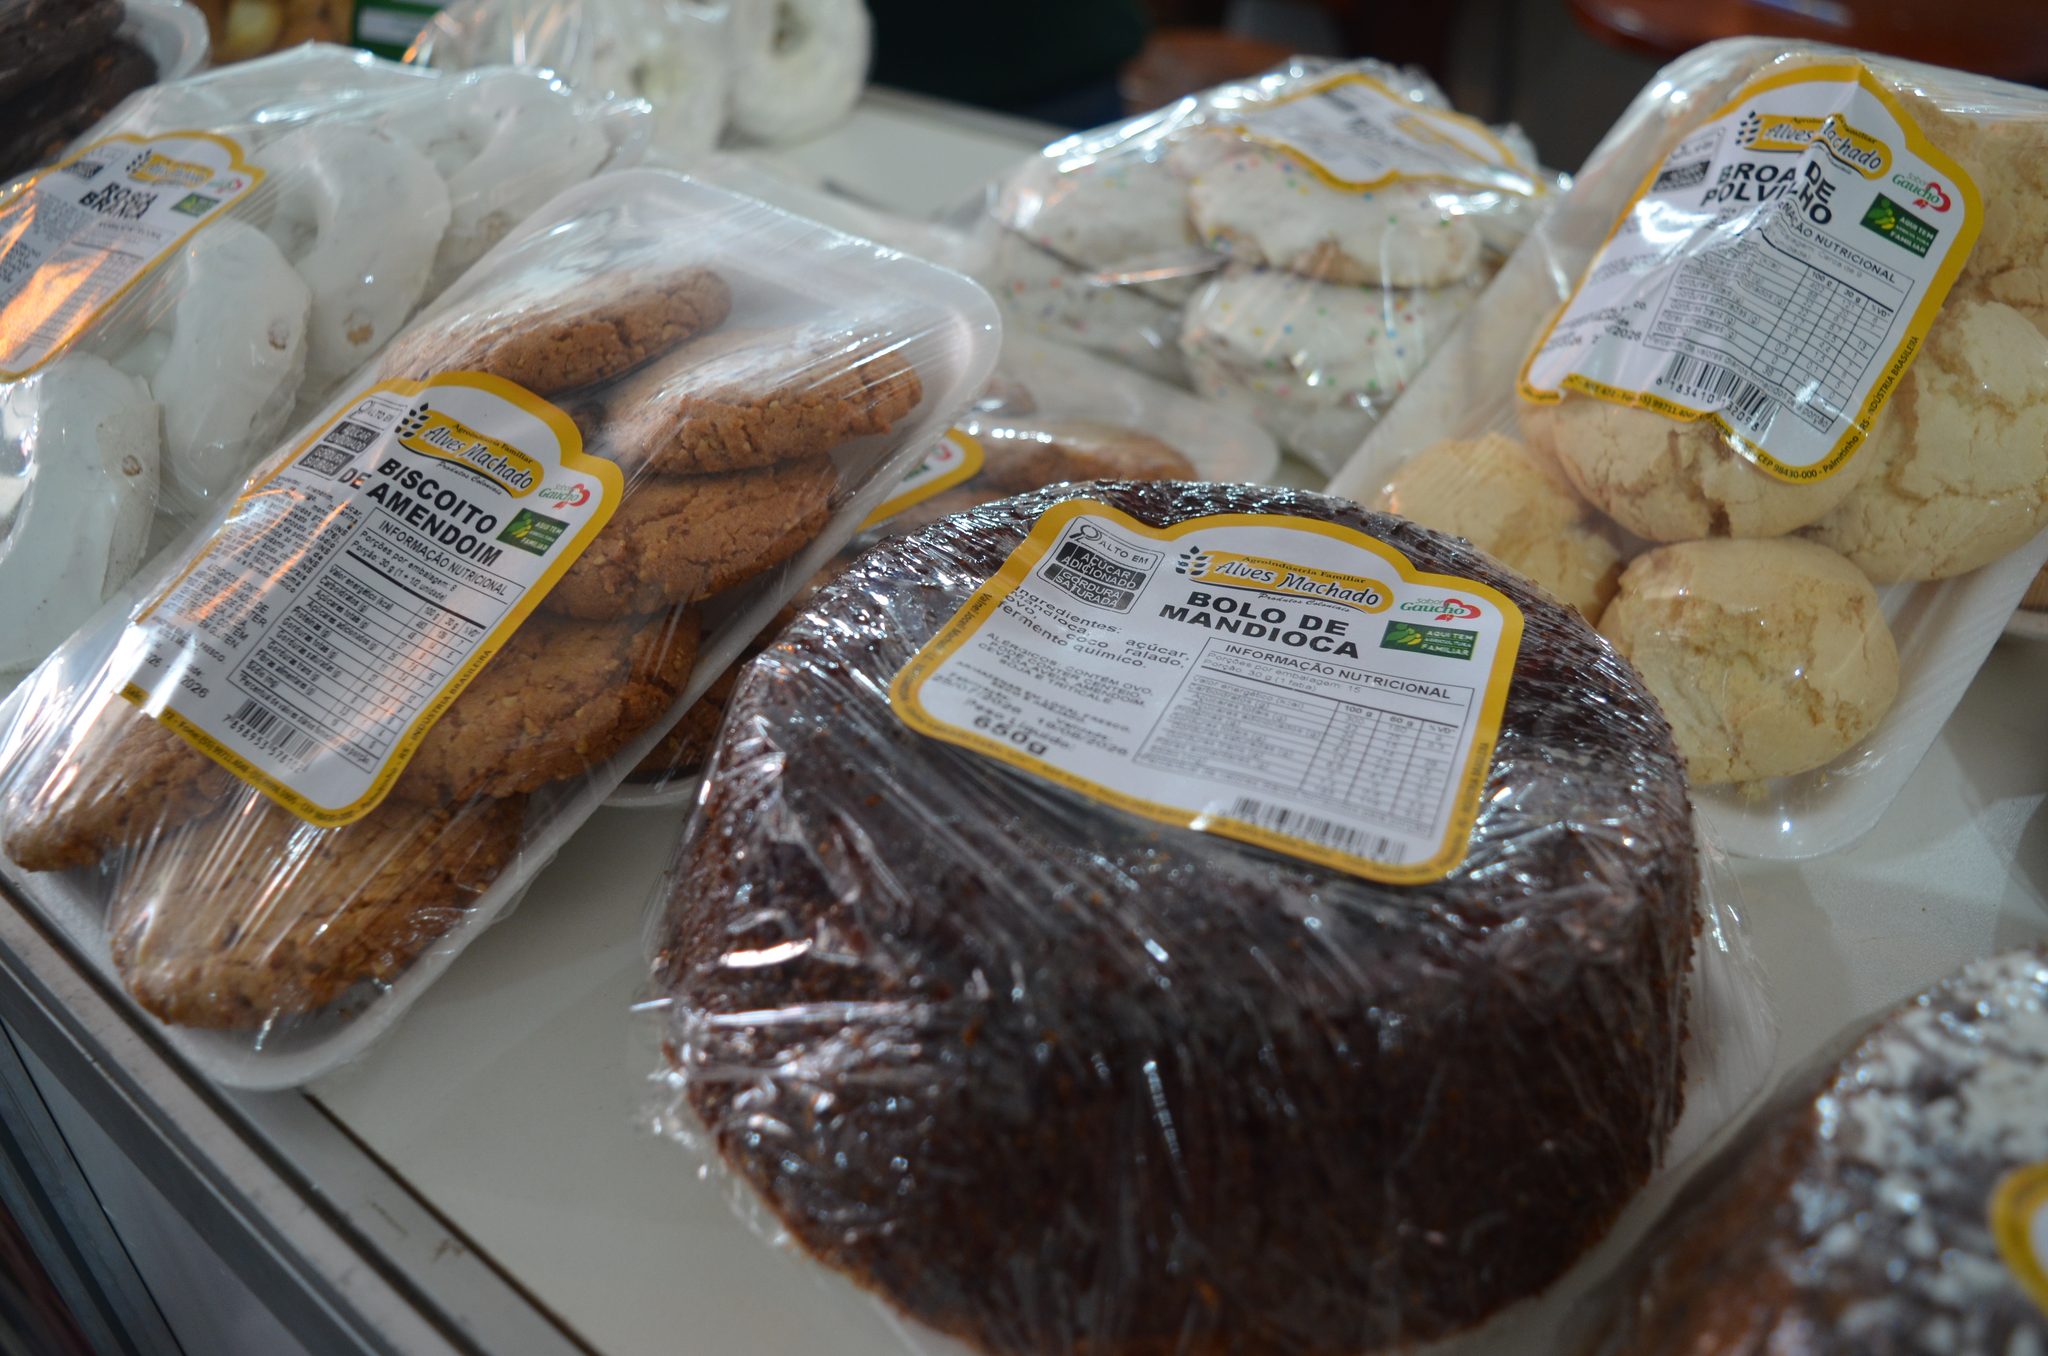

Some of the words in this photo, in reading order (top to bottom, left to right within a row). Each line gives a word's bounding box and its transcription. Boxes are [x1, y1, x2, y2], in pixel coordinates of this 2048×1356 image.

[1764, 123, 1813, 142] Alves
[1822, 118, 1881, 170] achado
[1718, 162, 1797, 184] BROA
[1804, 160, 1836, 204] DE
[1700, 181, 1833, 225] POLVILHO
[1814, 234, 1896, 284] NUTRICIONAL
[1811, 271, 1826, 283] 100
[1844, 288, 1855, 299] 30
[1757, 454, 1773, 467] CEP
[1774, 464, 1818, 479] 98430-000
[1823, 435, 1860, 473] Palmitinho
[1860, 419, 1871, 431] RS
[1867, 374, 1895, 416] INDÚSTRIA
[1891, 336, 1920, 376] BRASILEIRA
[424, 427, 465, 452] Alves
[459, 443, 533, 489] Machado
[501, 443, 534, 465] Familiar
[378, 458, 497, 535] BISCOITO
[338, 468, 372, 490] DE
[366, 482, 503, 567] AMENDOIM
[351, 540, 380, 562] Porção:
[379, 558, 391, 568] 30
[360, 530, 396, 556] Porções
[393, 553, 408, 566] por
[378, 520, 450, 568] INFORMAÇÃO
[449, 562, 509, 596] NUTRICIONAL
[1081, 552, 1131, 580] AÇÚCAR
[1100, 540, 1129, 559] ALTO
[1131, 555, 1149, 565] EM
[317, 576, 362, 606] Carboidratos
[327, 565, 348, 581] Valor
[343, 576, 379, 602] energético
[1055, 575, 1118, 607] SATURADA
[1061, 556, 1137, 590] ADICIONADO
[1062, 571, 1120, 599] GORDURA
[1216, 560, 1277, 583] Alves
[1277, 572, 1379, 606] Machado
[1320, 570, 1367, 584] Familiar
[1015, 586, 1123, 634] Ingredientes:
[1187, 591, 1287, 624] BOLO
[1298, 614, 1350, 637] DE
[1258, 591, 1303, 605] Produtos
[999, 601, 1069, 647] fermento
[1073, 643, 1147, 668] químico.
[1005, 595, 1038, 619] ovo,
[1066, 632, 1109, 649] coco
[1125, 646, 1185, 668] ralado,
[1126, 638, 1190, 661] açúcar,
[1158, 604, 1359, 659] MANDIOCA
[1421, 643, 1470, 656] FAMILIAR
[1426, 630, 1452, 638] AQUI
[1452, 632, 1474, 641] TEM
[990, 640, 1026, 658] PODE
[1027, 655, 1082, 681] CONTER
[1000, 657, 1032, 676] SOJA
[1066, 665, 1119, 685] CONTÉM
[1205, 652, 1253, 668] Porções
[1253, 664, 1273, 673] por
[1346, 685, 1361, 693] 15
[1225, 644, 1335, 675] INFORMAÇÃO
[1338, 670, 1451, 700] NUTRICIONAL
[1246, 670, 1263, 678] 30
[1343, 704, 1363, 714] 100
[1388, 716, 1403, 724] 60
[973, 713, 1049, 757] 650g
